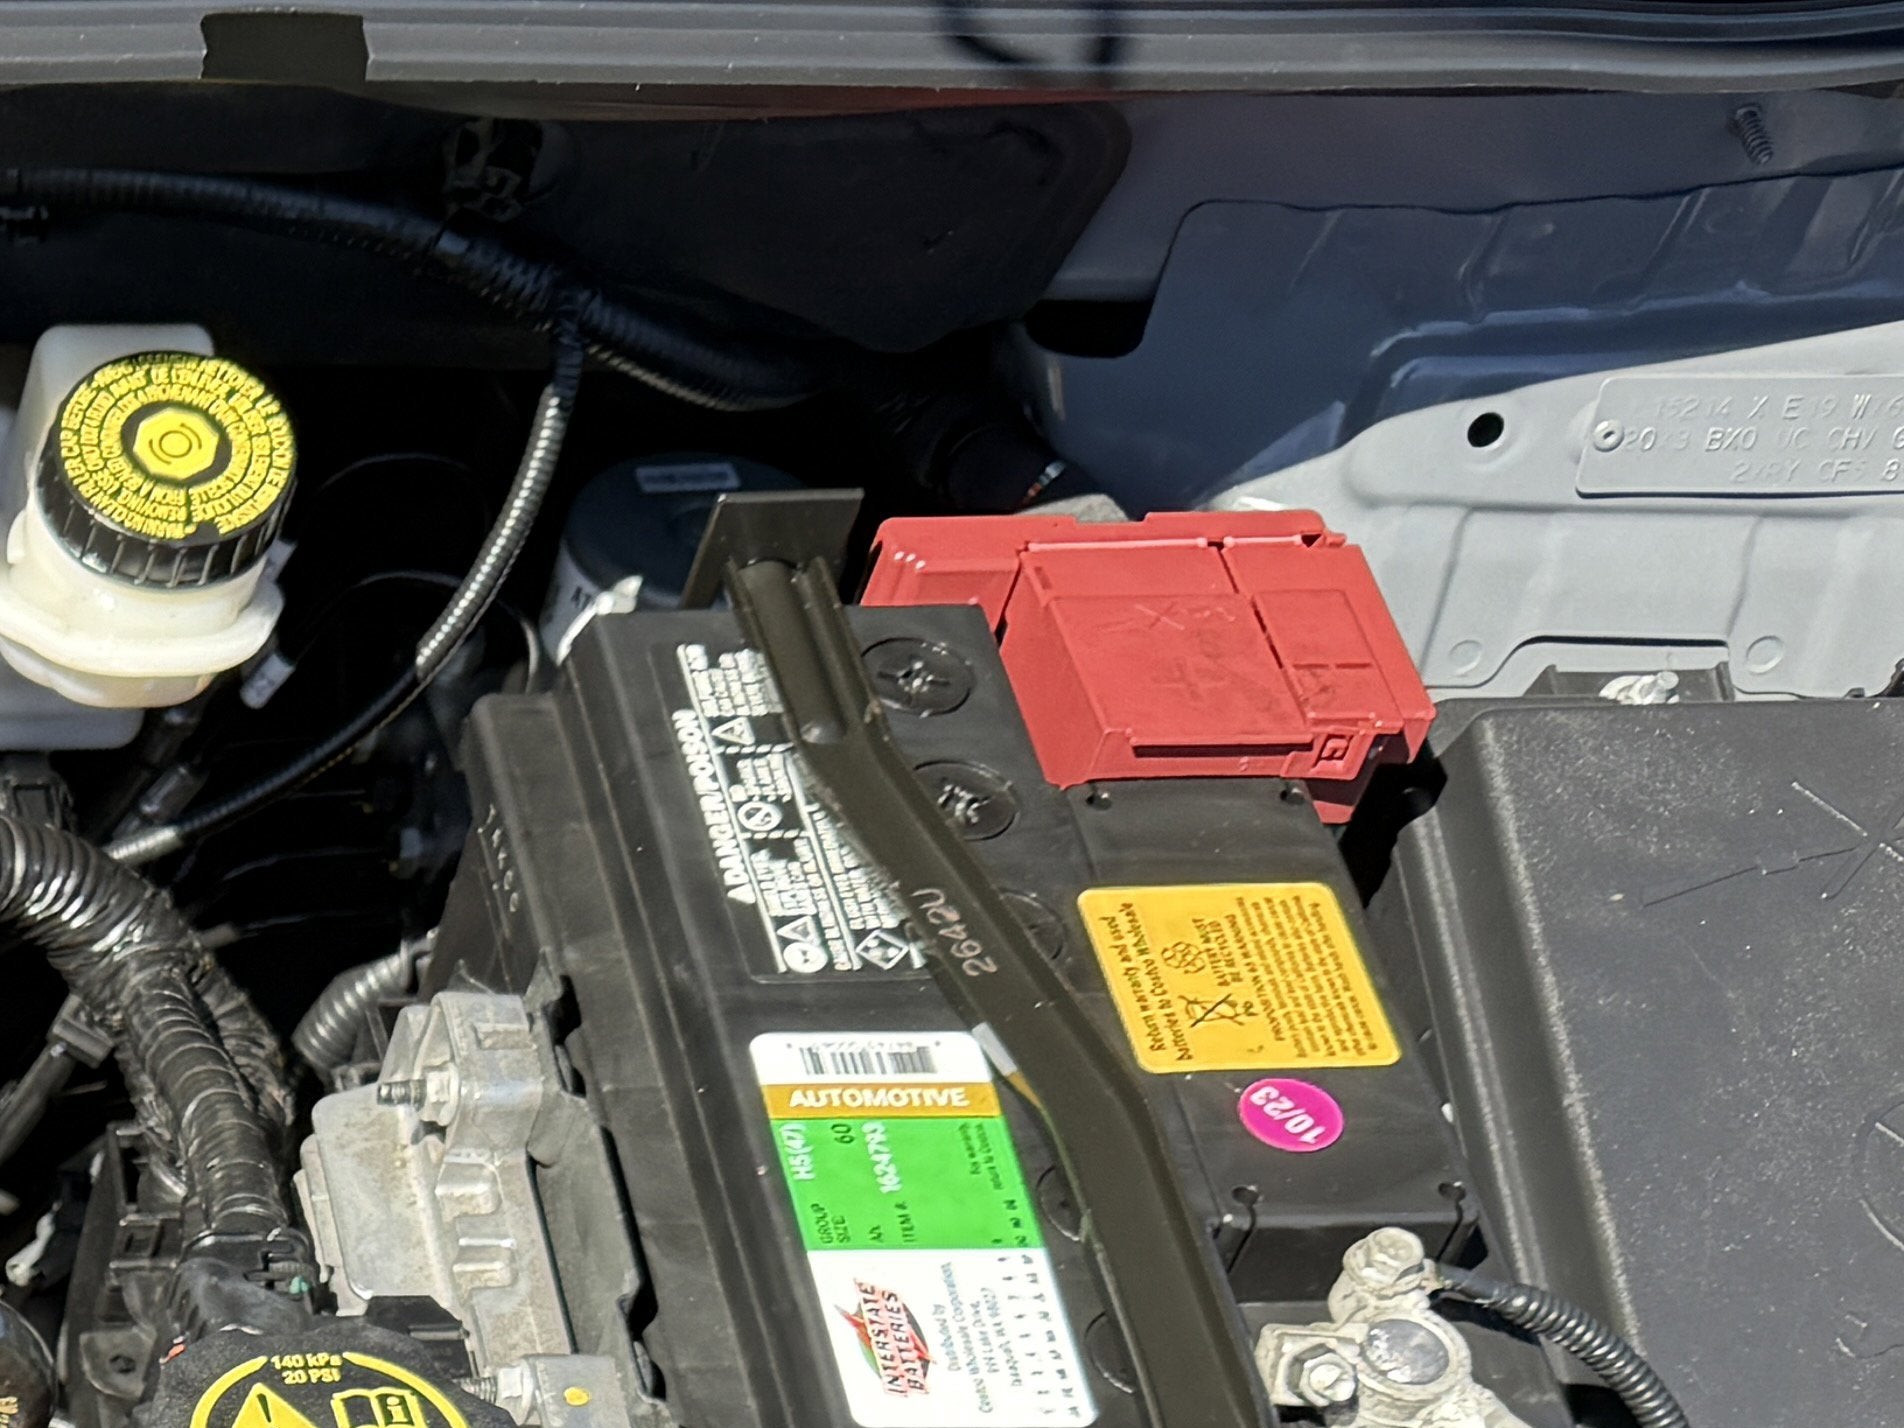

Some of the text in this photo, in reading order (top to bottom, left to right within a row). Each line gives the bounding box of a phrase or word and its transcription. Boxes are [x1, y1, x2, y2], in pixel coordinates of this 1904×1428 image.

[671, 709, 750, 887] DANGER/POISON
[1098, 915, 1167, 1051] Return warranty and used
[789, 1086, 971, 1109] AUTOMOTIVE
[1249, 1085, 1326, 1144] 10/23
[831, 1123, 854, 1143] 60
[811, 1203, 834, 1243] GROUP
[832, 1215, 850, 1243] SIZE
[898, 1214, 916, 1242] ITEM
[859, 1281, 905, 1393] INTERSTATE
[881, 1289, 922, 1389] BATTERIES
[934, 1317, 961, 1371] Distributed
[270, 1353, 343, 1370] 140 kPa
[282, 1367, 342, 1385] 20 PSI
